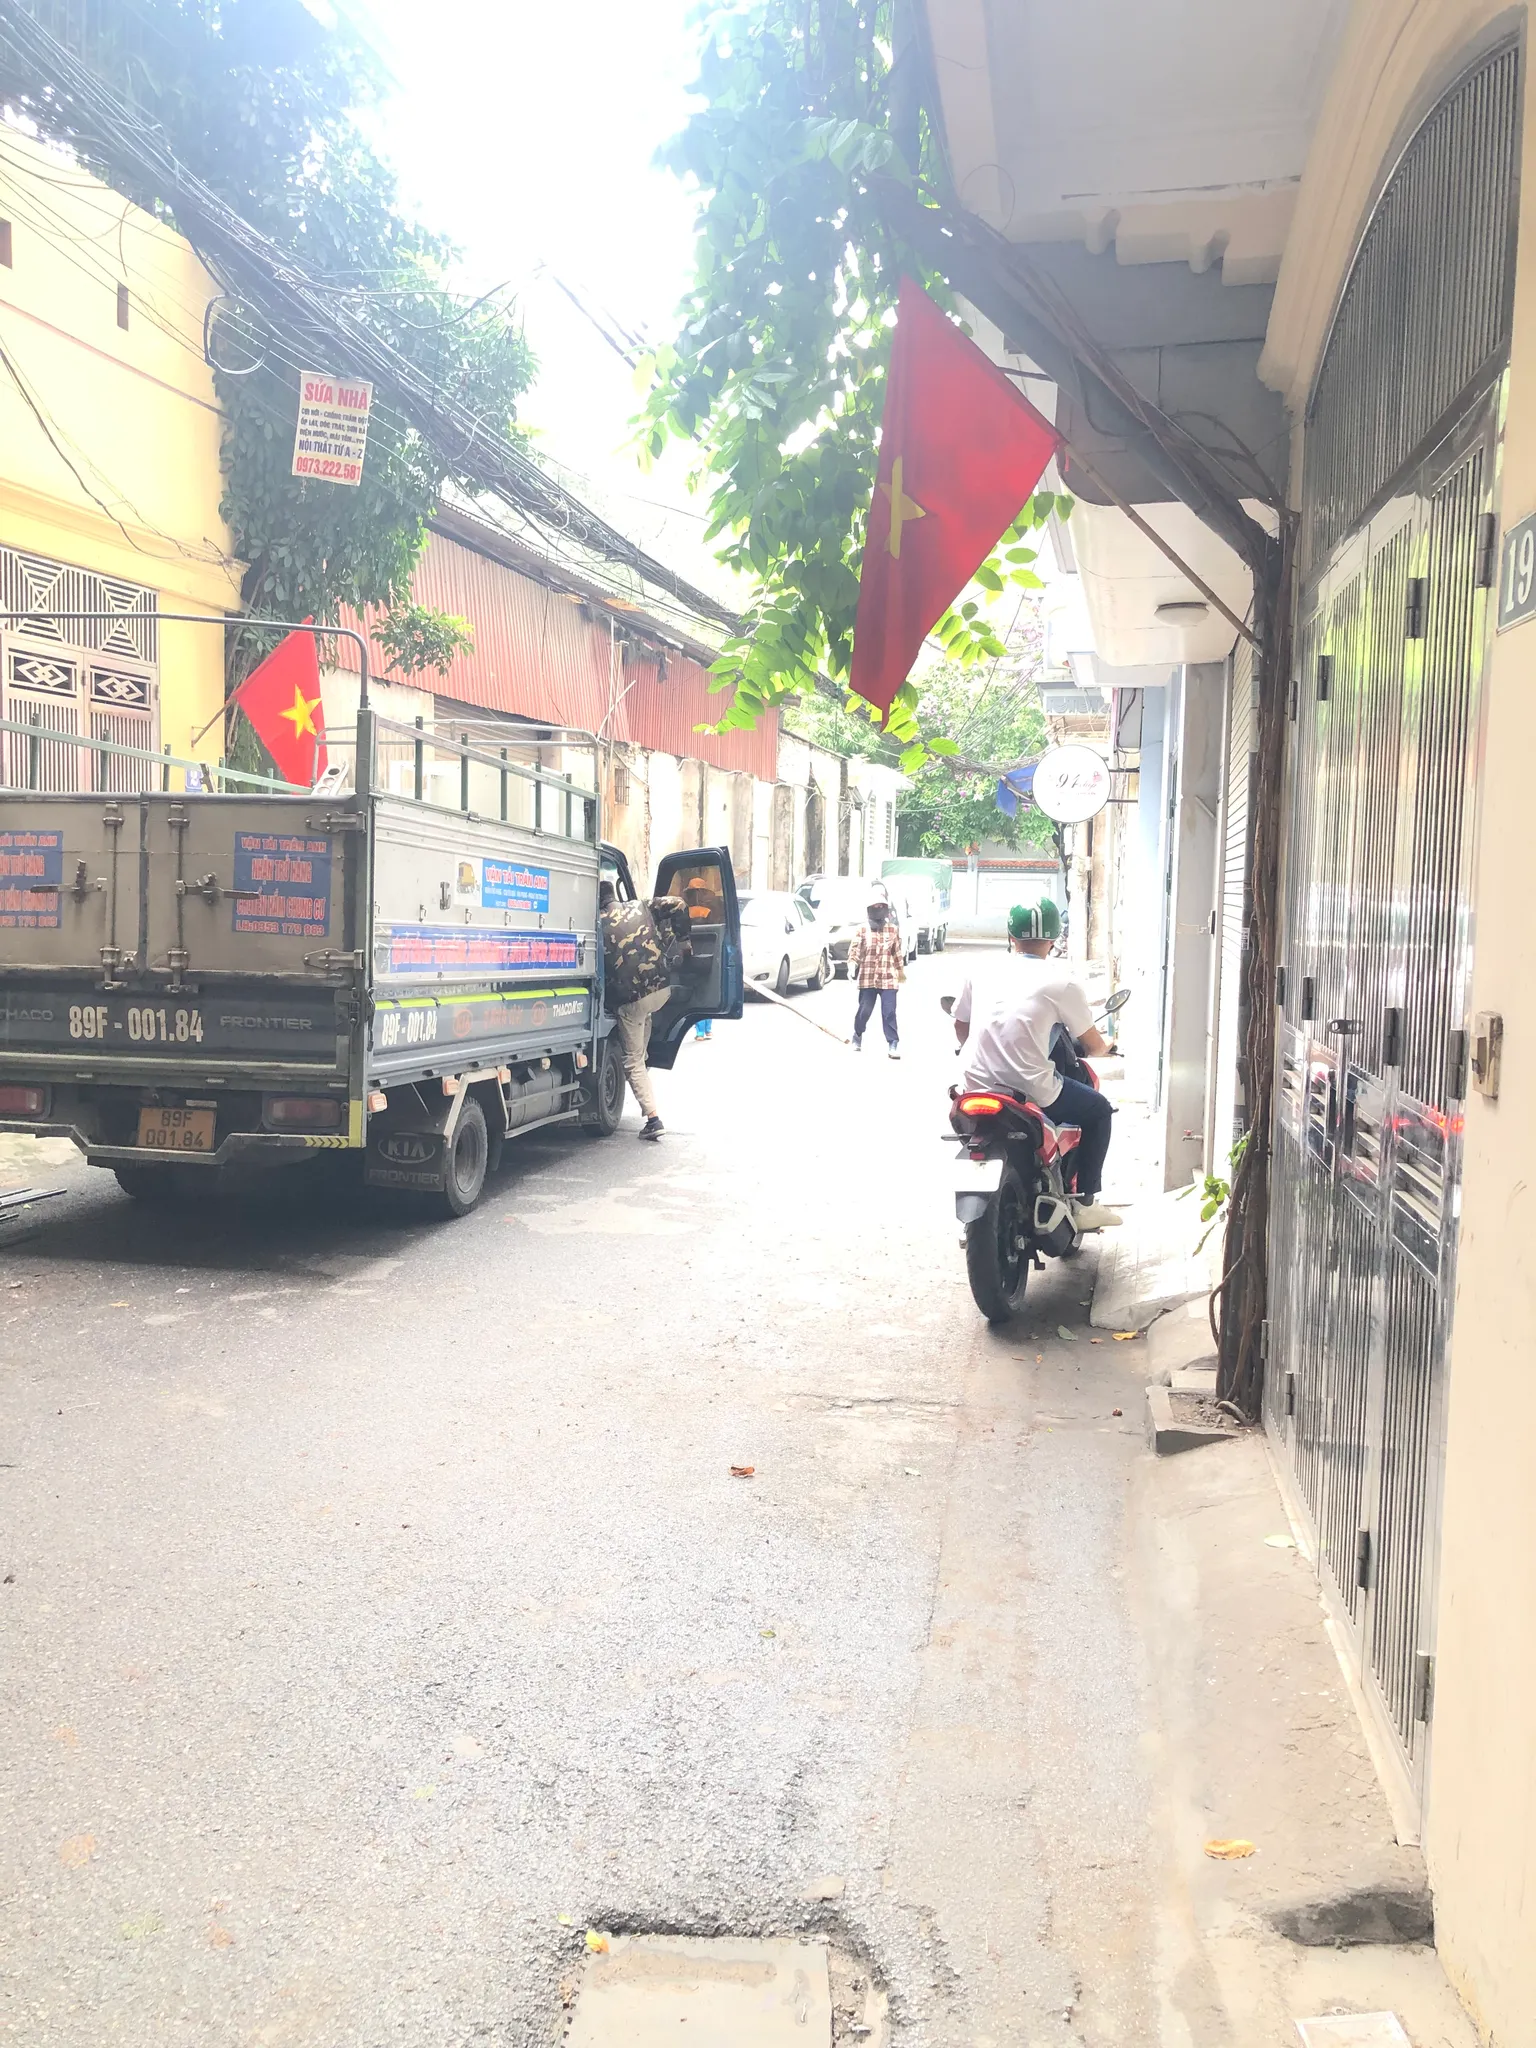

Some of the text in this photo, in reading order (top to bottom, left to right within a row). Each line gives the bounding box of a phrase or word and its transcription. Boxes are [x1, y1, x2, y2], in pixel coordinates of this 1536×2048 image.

[304, 378, 368, 410] SỬA NHÀ
[298, 438, 312, 454] NỘI
[314, 440, 332, 454] THẤT
[344, 447, 351, 458] A
[357, 449, 363, 459] Z
[1504, 529, 1534, 614] 19
[69, 1006, 204, 1042] 89F - 001.84
[219, 1015, 312, 1030] FRONTIER
[381, 1012, 400, 1046] 89F
[406, 1010, 437, 1042] 001.84
[161, 1110, 193, 1127] 89F
[146, 1129, 204, 1147] 001.84
[388, 1140, 426, 1158] KIA
[368, 1169, 440, 1186] FRONTIER
